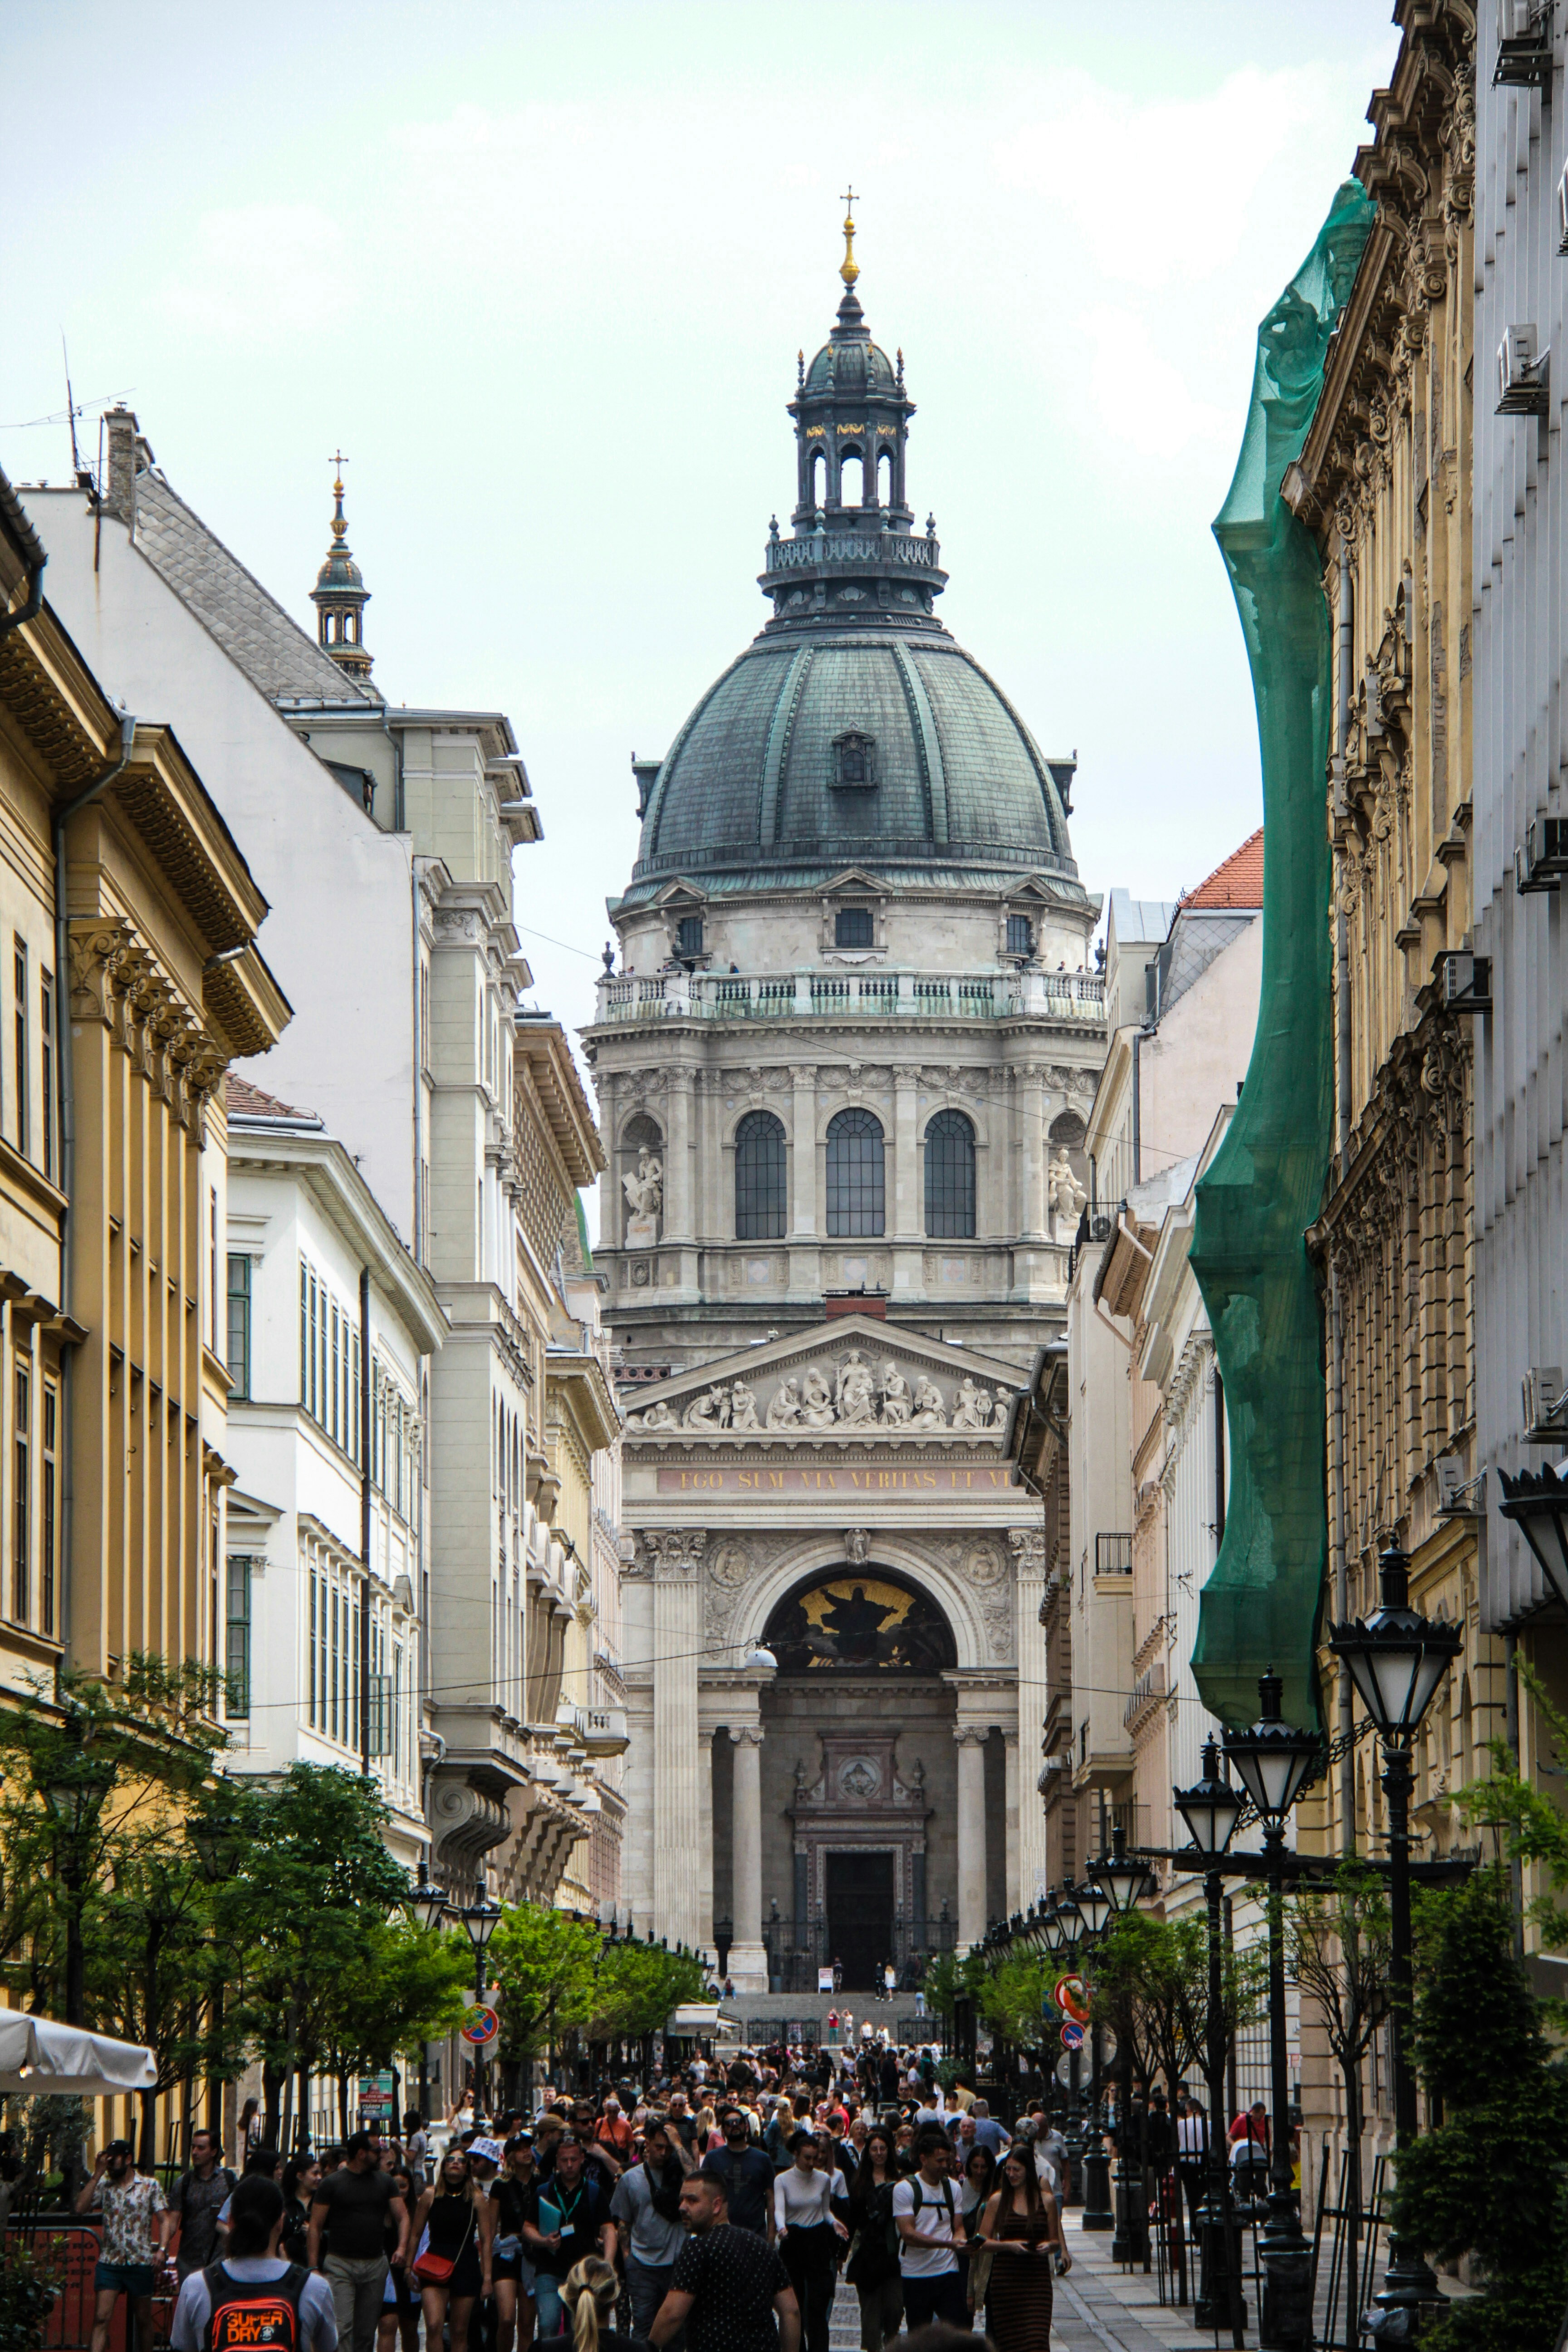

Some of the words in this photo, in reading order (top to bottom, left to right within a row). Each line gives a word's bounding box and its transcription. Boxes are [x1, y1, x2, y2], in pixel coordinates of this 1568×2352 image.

[680, 1473, 723, 1490] EGO
[738, 1473, 784, 1489] SUM
[801, 1472, 838, 1489] VIA
[851, 1472, 937, 1489] VERITAS
[951, 1472, 975, 1489] ET
[227, 2310, 283, 2328] SUPER
[227, 2326, 261, 2342] DRY
